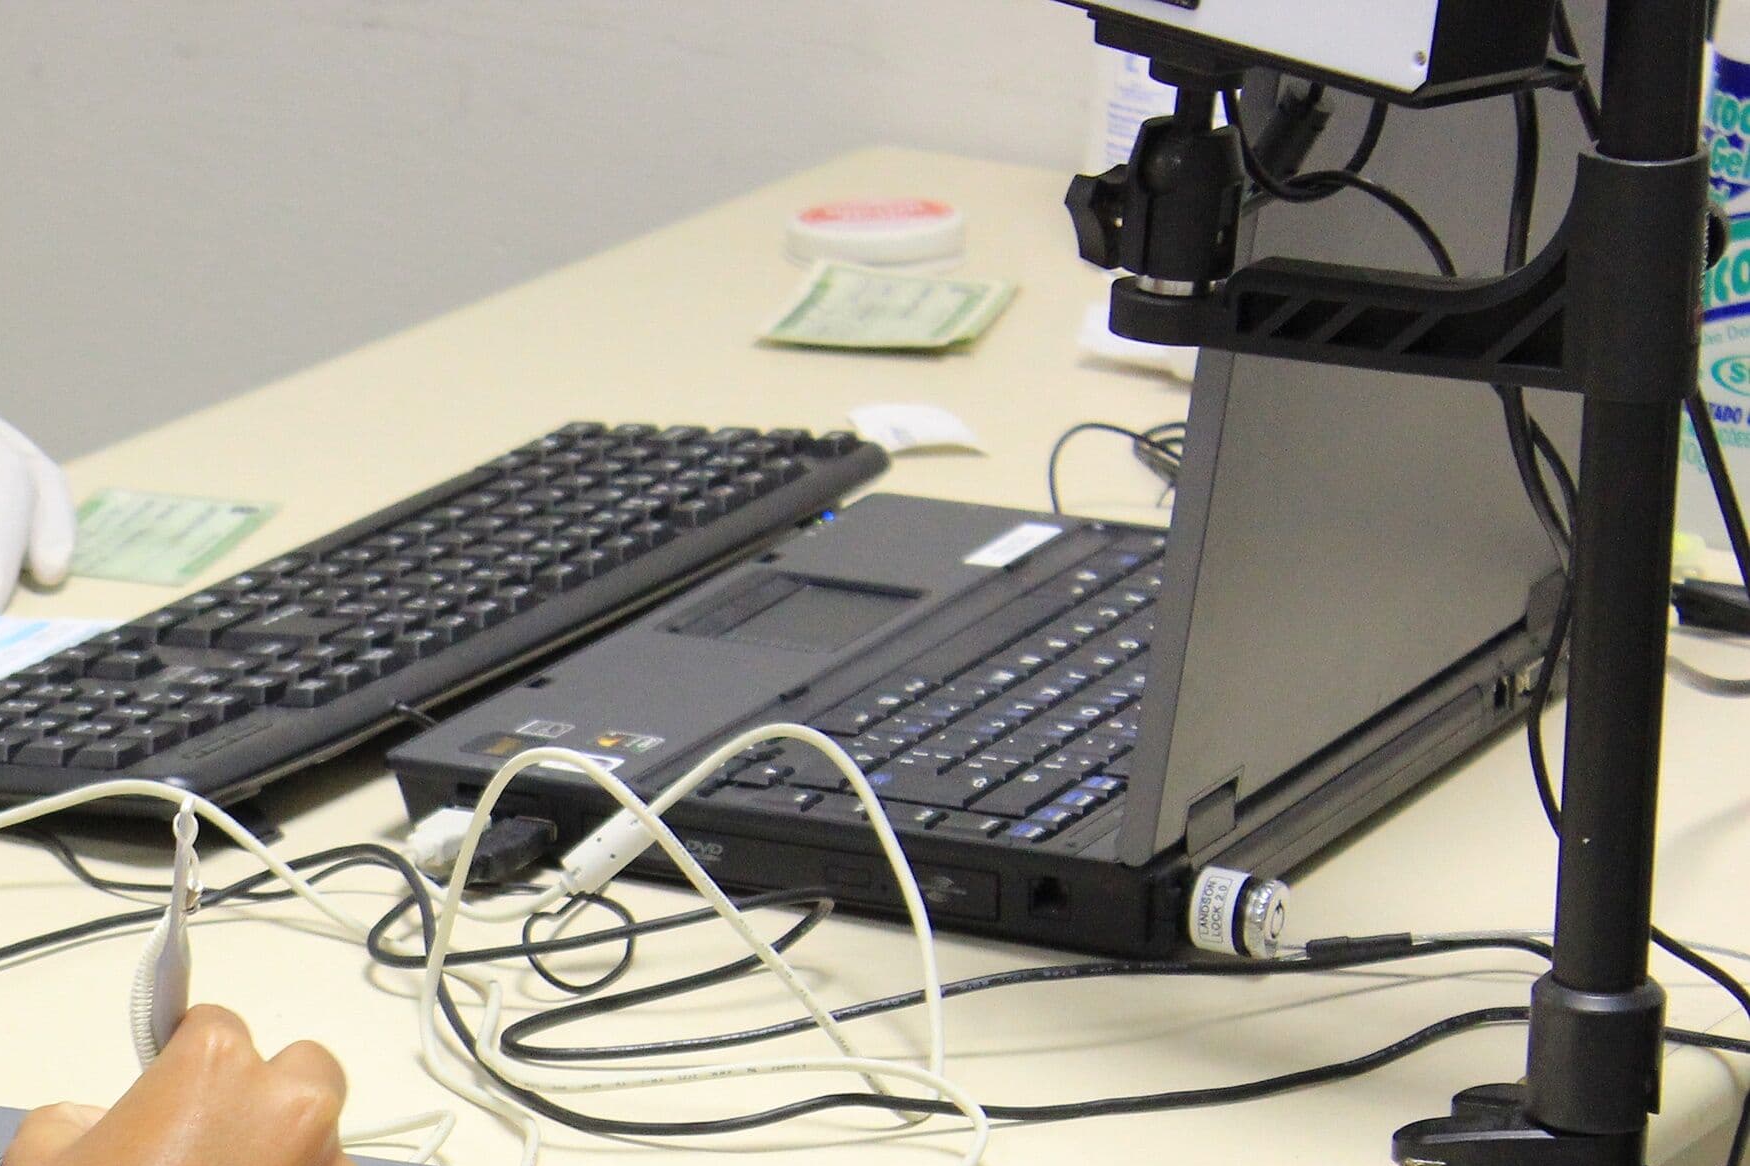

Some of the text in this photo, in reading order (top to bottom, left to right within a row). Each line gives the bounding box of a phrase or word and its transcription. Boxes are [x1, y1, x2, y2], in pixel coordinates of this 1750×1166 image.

[1199, 881, 1217, 936] LANDSON
[1211, 885, 1228, 937] LOCK 2.0
